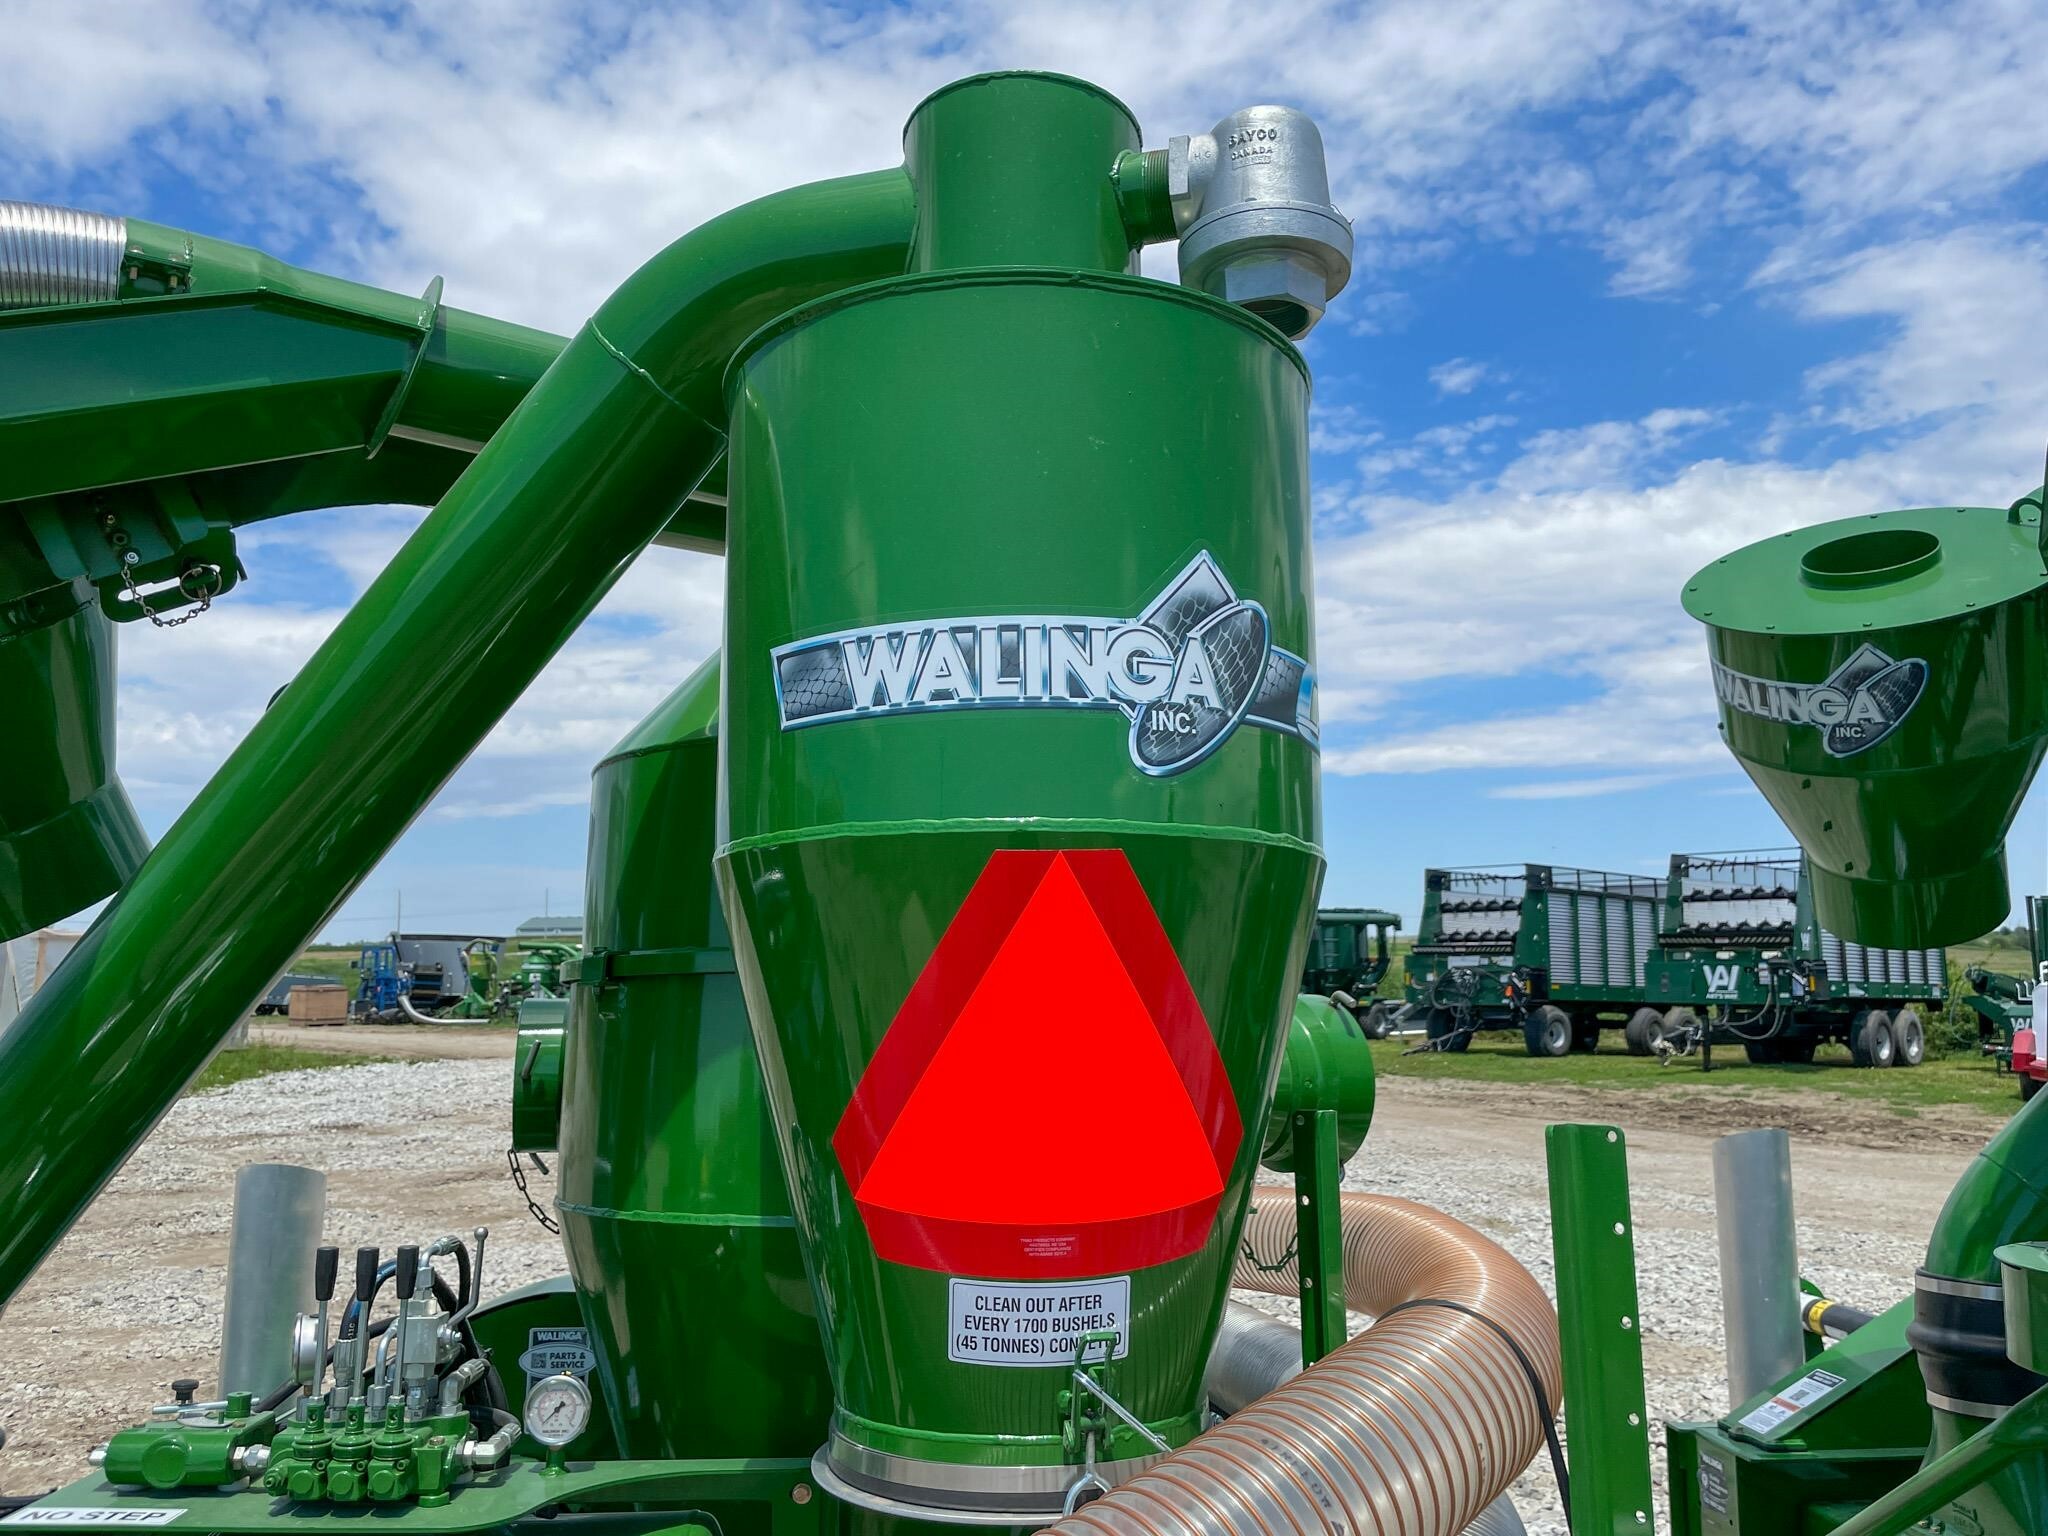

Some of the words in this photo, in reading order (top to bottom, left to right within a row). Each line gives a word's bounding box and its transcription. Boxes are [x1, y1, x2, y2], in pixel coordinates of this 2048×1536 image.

[1231, 146, 1273, 161] CANADA
[842, 624, 1223, 710] WALINGA
[1713, 665, 1886, 725] WALINGA
[1151, 709, 1197, 735] INC.
[1835, 726, 1867, 739] INC.
[975, 1295, 1021, 1312] CLEAN
[1026, 1297, 1055, 1313] OUT
[1059, 1294, 1102, 1312] AFTER
[964, 1314, 1009, 1332] EVERY
[1014, 1318, 1048, 1333] 1700
[1052, 1312, 1115, 1332] BUSHELS
[536, 1331, 583, 1341] WALINGA
[956, 1333, 978, 1352] (45
[982, 1336, 1045, 1357] TONNES)
[549, 1352, 577, 1360] PARTS
[579, 1352, 586, 1360] &
[19, 1511, 74, 1521] NO
[79, 1511, 167, 1521] STEP
